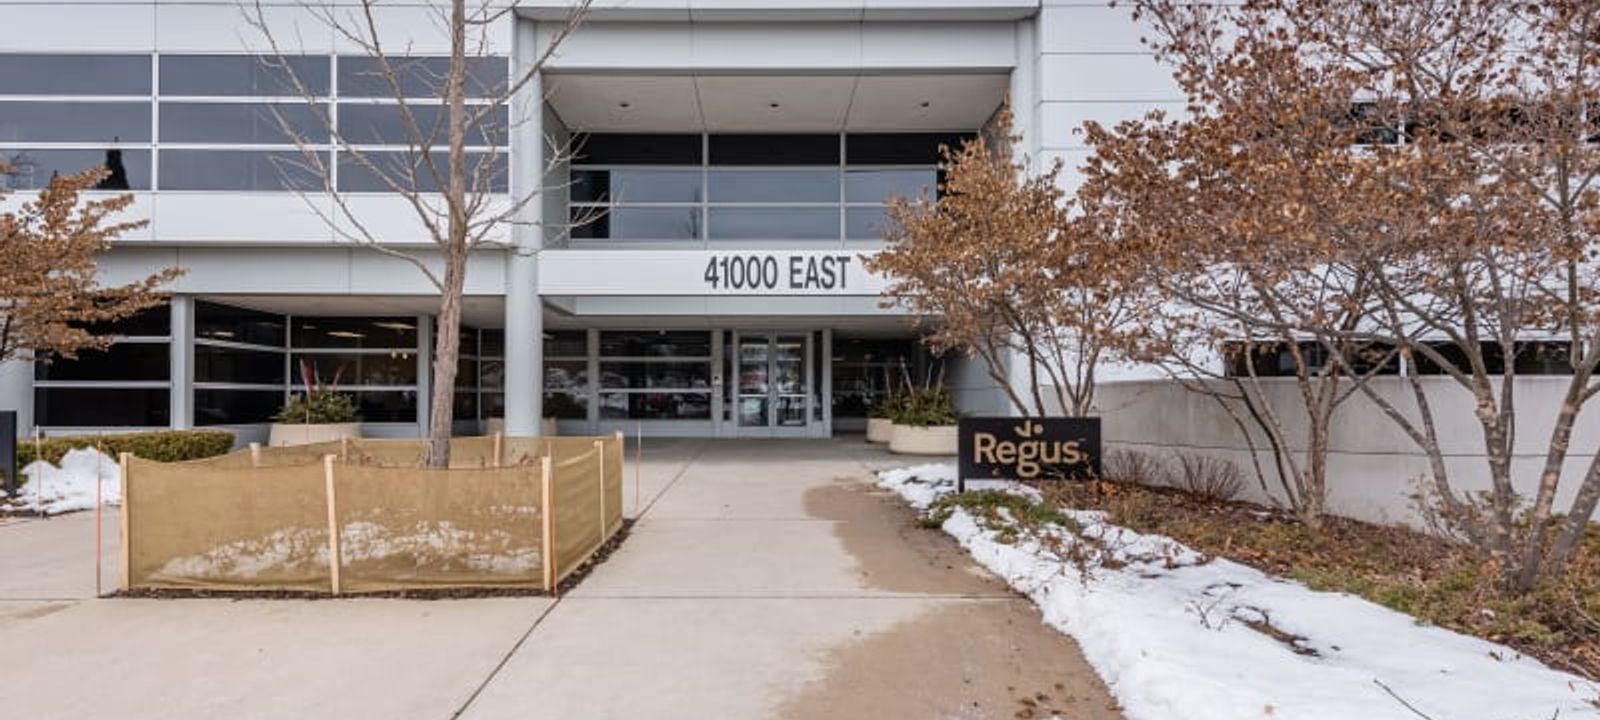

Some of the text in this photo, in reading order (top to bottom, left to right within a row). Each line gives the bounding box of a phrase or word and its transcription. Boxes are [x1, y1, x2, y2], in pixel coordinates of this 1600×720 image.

[704, 255, 851, 289] 41000 EAST
[974, 432, 1081, 478] Regus
